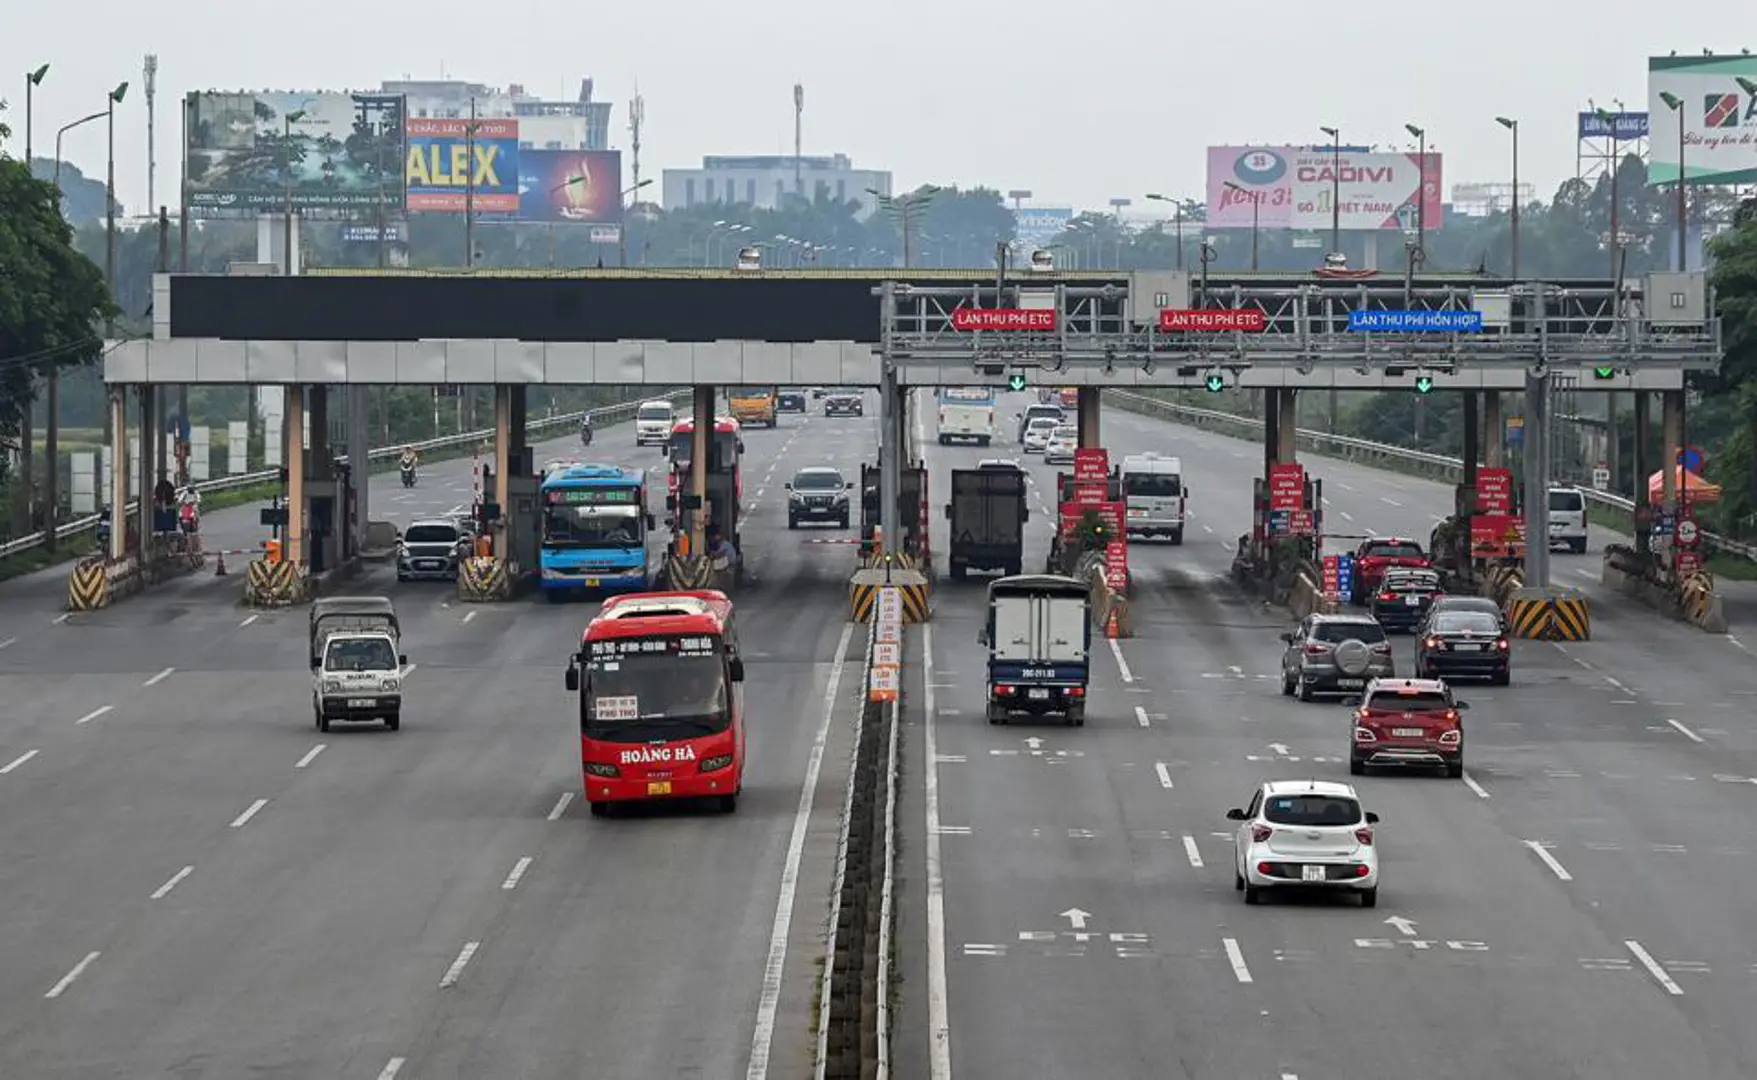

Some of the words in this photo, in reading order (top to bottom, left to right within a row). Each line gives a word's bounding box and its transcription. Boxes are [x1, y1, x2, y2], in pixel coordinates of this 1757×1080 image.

[406, 144, 501, 187] ALEX
[1296, 166, 1394, 183] CADIVI
[1362, 202, 1394, 214] NAM
[957, 311, 982, 325] LÀN
[983, 314, 1005, 325] THU
[1008, 310, 1028, 325] PHÍ
[1028, 314, 1052, 325] ETC
[1164, 311, 1189, 325] LÀN
[1190, 314, 1213, 325] THU
[1215, 310, 1235, 325] PHÍ
[1236, 314, 1259, 325] ETC
[1353, 312, 1377, 326] LÀN
[1381, 314, 1403, 325] THU
[1405, 312, 1425, 326] PHÍ
[621, 746, 671, 764] HOÀNG
[675, 744, 696, 761] HÀ
